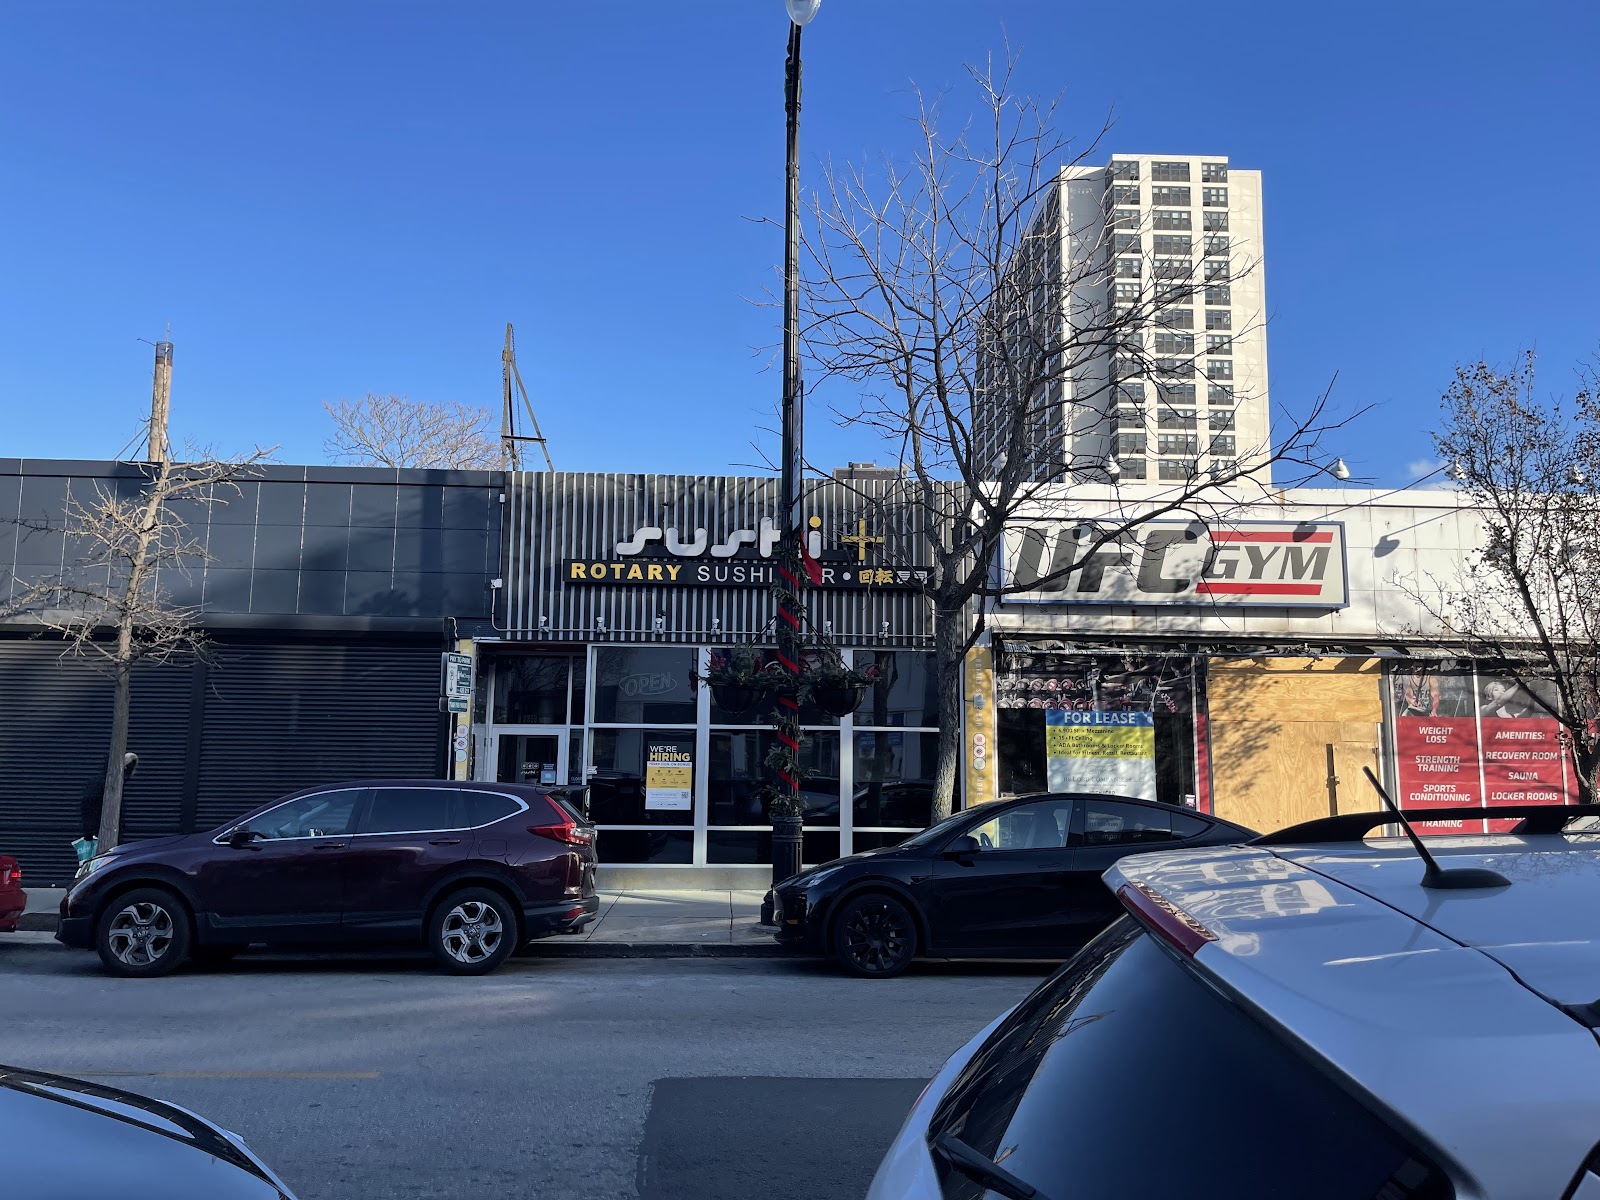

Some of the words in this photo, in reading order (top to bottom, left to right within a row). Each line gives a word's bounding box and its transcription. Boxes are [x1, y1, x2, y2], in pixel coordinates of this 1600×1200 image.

[1013, 528, 1198, 593] UFC
[1203, 545, 1331, 581] GYM
[571, 562, 682, 581] ROTARY
[697, 565, 773, 583] SUSHI
[624, 672, 671, 697] OPEN
[1064, 712, 1091, 723] FOR
[1096, 712, 1136, 724] LEASE
[1419, 727, 1453, 735] WEIGHT
[1495, 731, 1545, 740] AMENITIES:
[1425, 735, 1447, 744] LOSS
[649, 745, 678, 753] WE'RE
[649, 752, 691, 762] HIRING
[1415, 755, 1460, 764] STRENGTH
[1485, 751, 1530, 760] RECOVERY
[1531, 751, 1558, 760] ROOM
[1417, 764, 1459, 773] TRAINING
[1508, 772, 1538, 780] SAUNA
[1423, 784, 1456, 793] SPORTS
[1409, 793, 1471, 802] CONDITIONING
[1491, 792, 1525, 801] LOCKER
[1526, 792, 1558, 801] ROOMS
[1422, 819, 1463, 828] TRAINING
